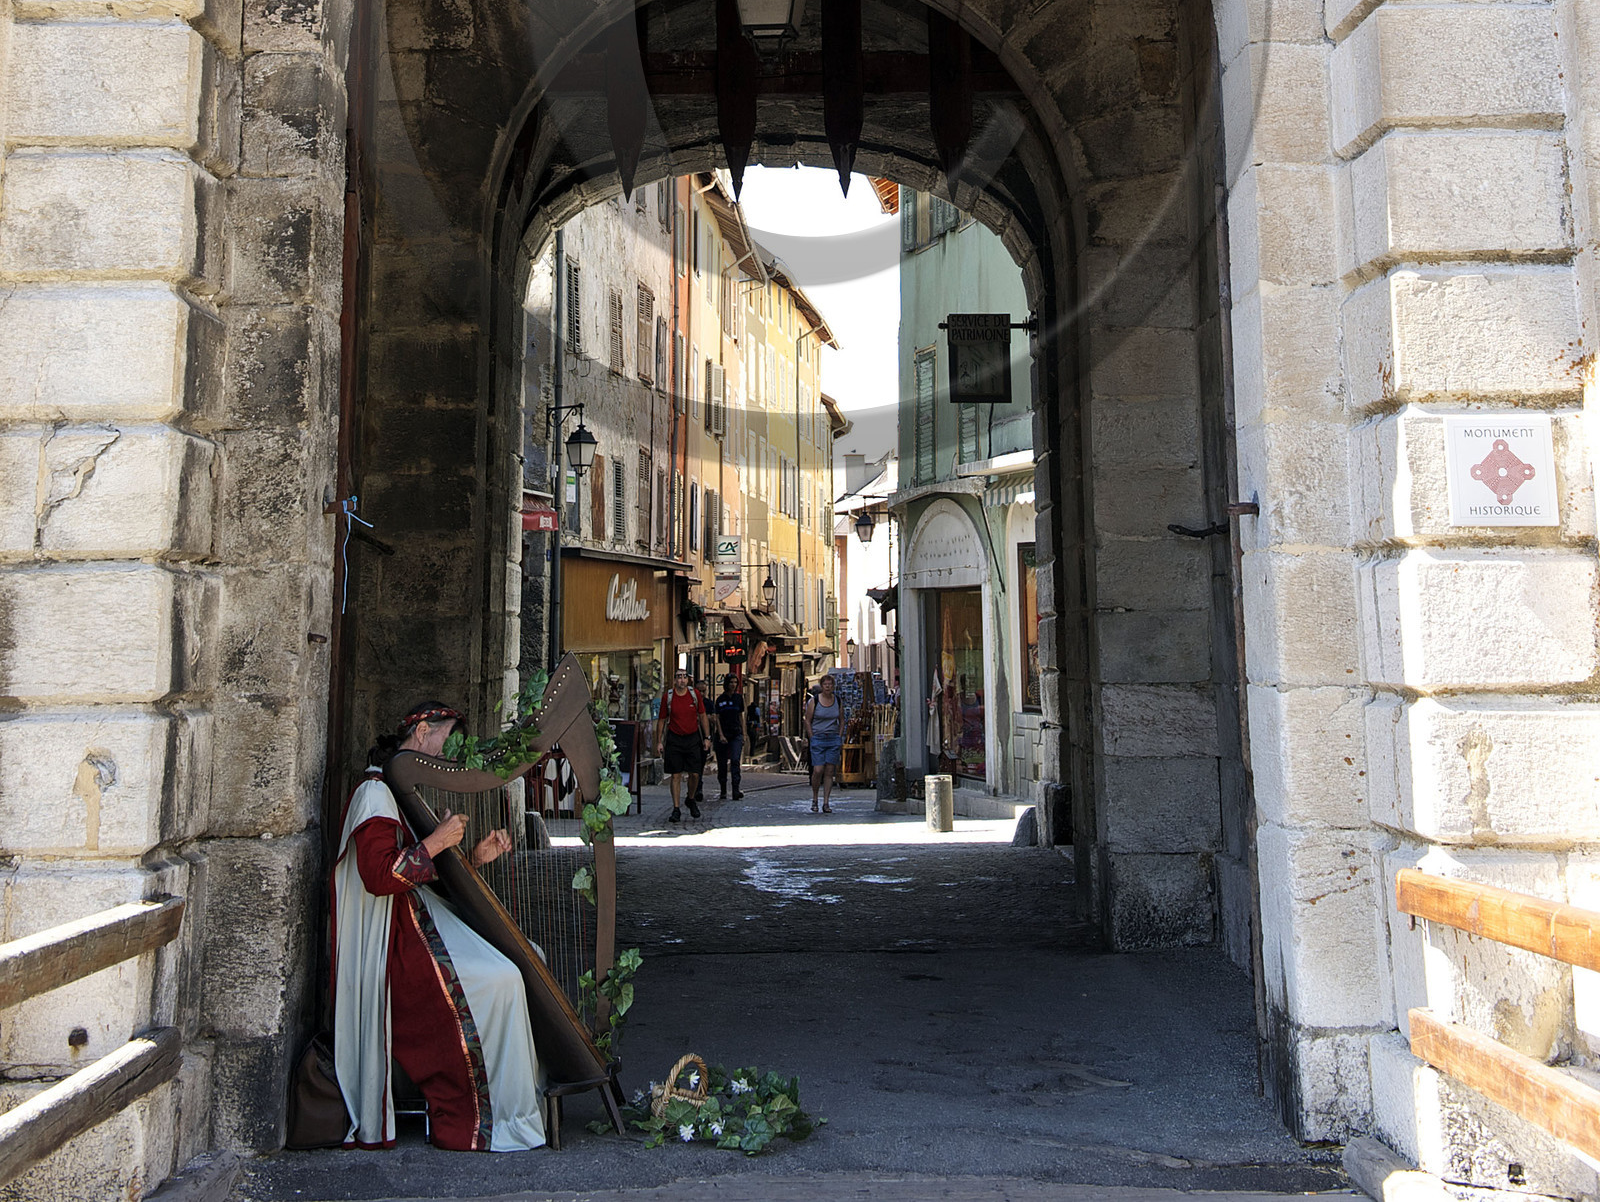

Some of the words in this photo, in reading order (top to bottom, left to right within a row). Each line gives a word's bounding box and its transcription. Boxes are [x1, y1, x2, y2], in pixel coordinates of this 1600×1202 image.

[951, 315, 990, 327] SERVICE
[994, 315, 1009, 327] DU
[951, 329, 1009, 341] PATRIMOINE
[1464, 428, 1534, 438] MONUMENT
[1469, 505, 1541, 516] HISTORIQUE
